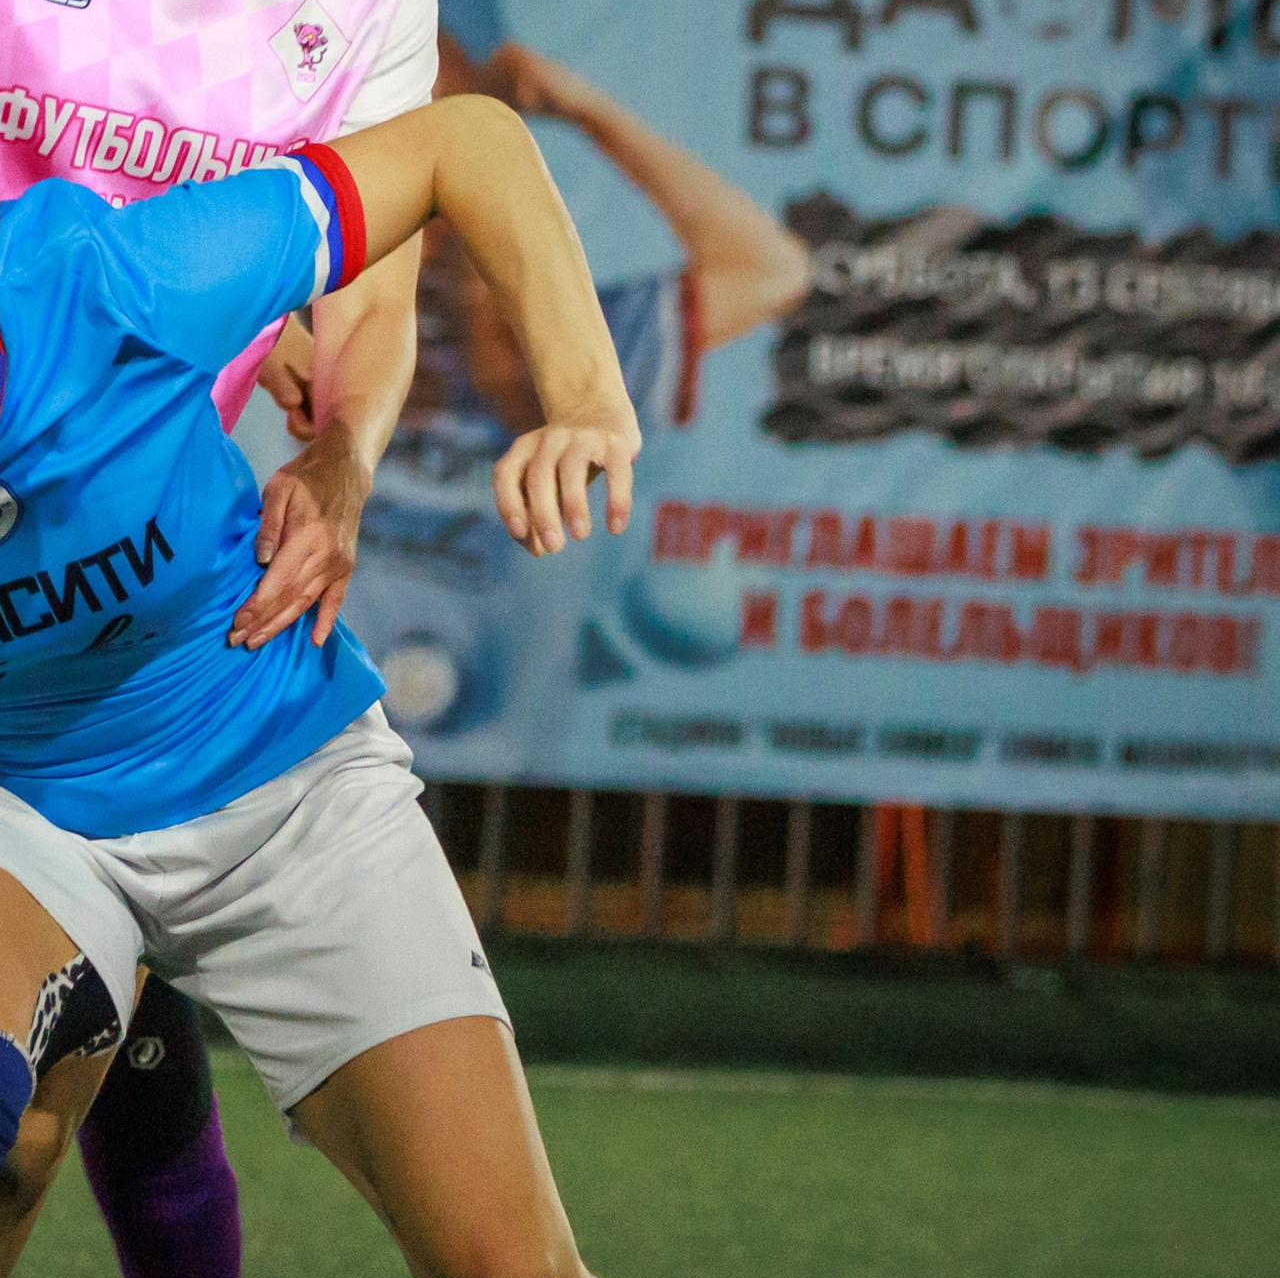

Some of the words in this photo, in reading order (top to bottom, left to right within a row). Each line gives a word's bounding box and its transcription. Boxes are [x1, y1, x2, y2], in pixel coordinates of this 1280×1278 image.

[750, 65, 812, 150] В
[855, 74, 1280, 186] СПОРТ
[652, 501, 1051, 579] ПРИГЛАШАЕМ
[741, 592, 777, 649] И
